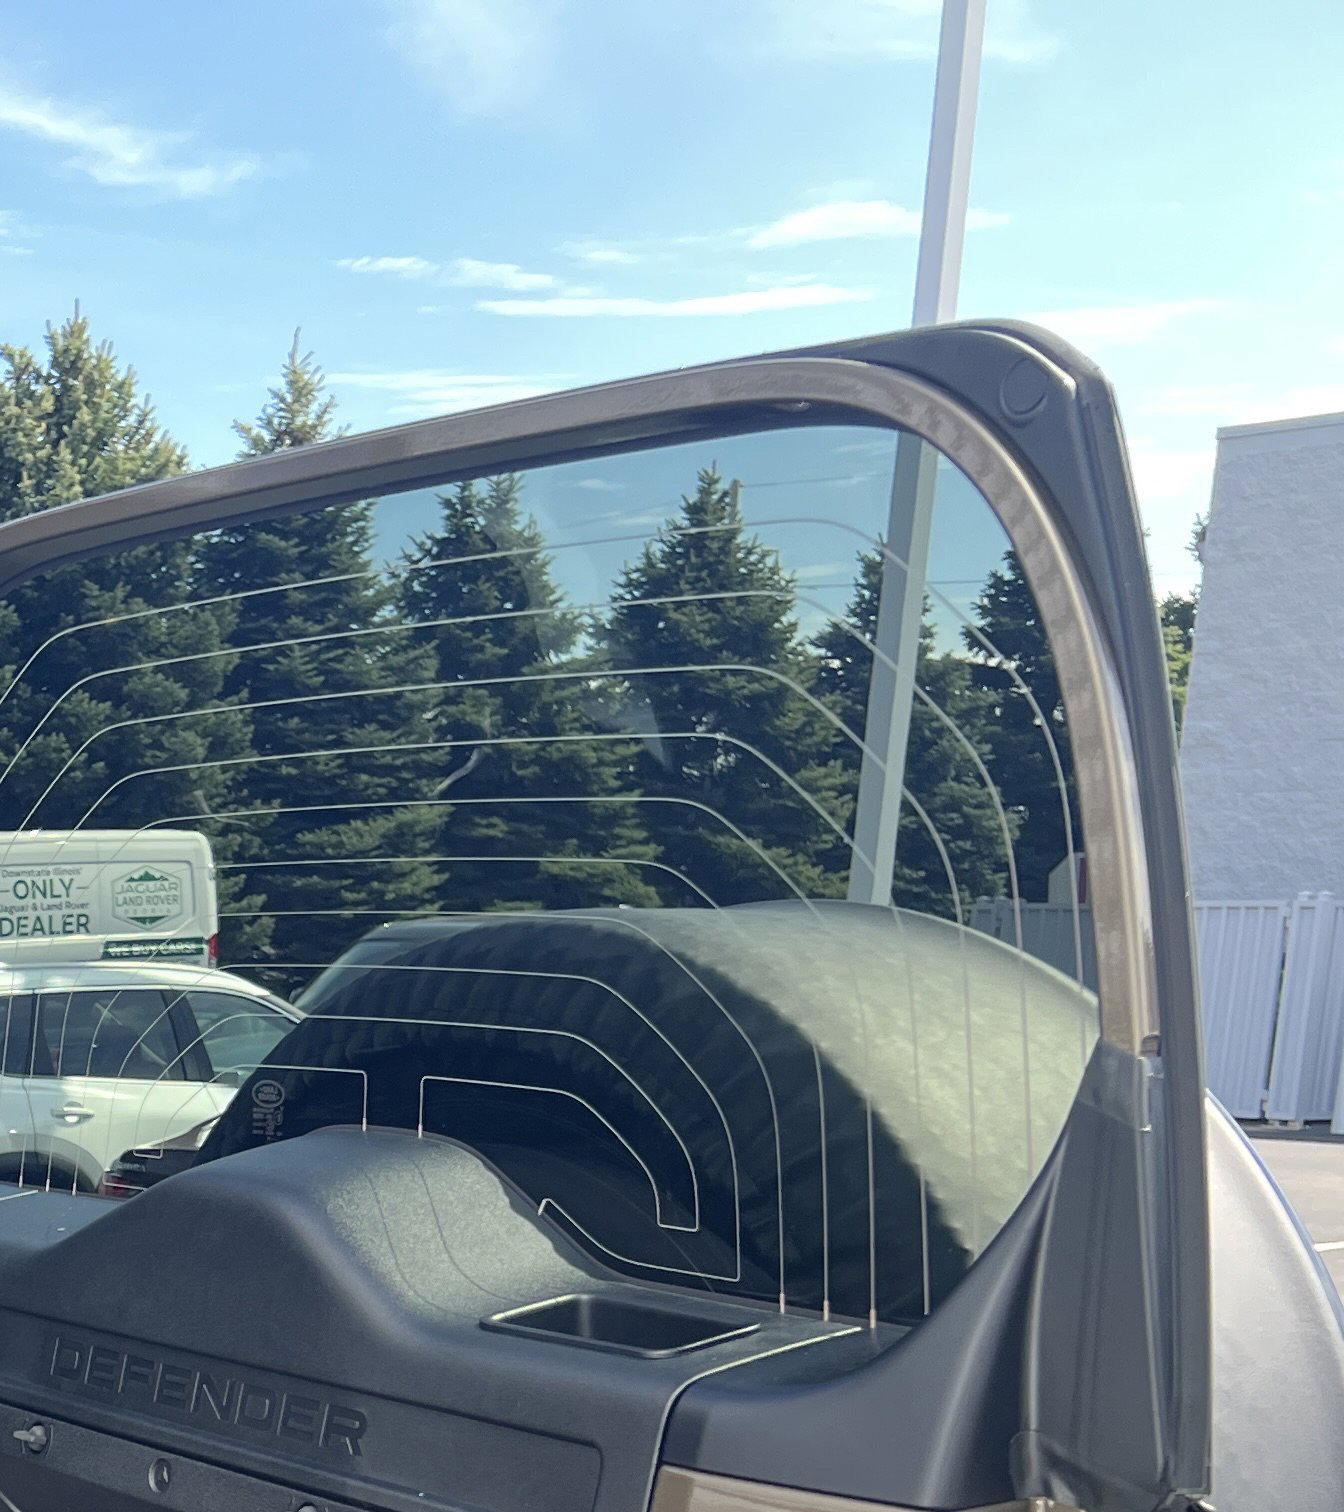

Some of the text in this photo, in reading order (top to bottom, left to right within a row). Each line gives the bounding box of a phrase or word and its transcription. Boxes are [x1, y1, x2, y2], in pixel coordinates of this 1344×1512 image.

[13, 878, 74, 900] ONLY
[115, 882, 178, 894] JAGUAR
[0, 903, 29, 915] Jaguar
[40, 902, 63, 911] Land
[65, 901, 90, 910] Rover
[115, 894, 179, 907] LAND ROVER
[0, 914, 90, 938] DEALER
[49, 1336, 369, 1458] DEFENDER
